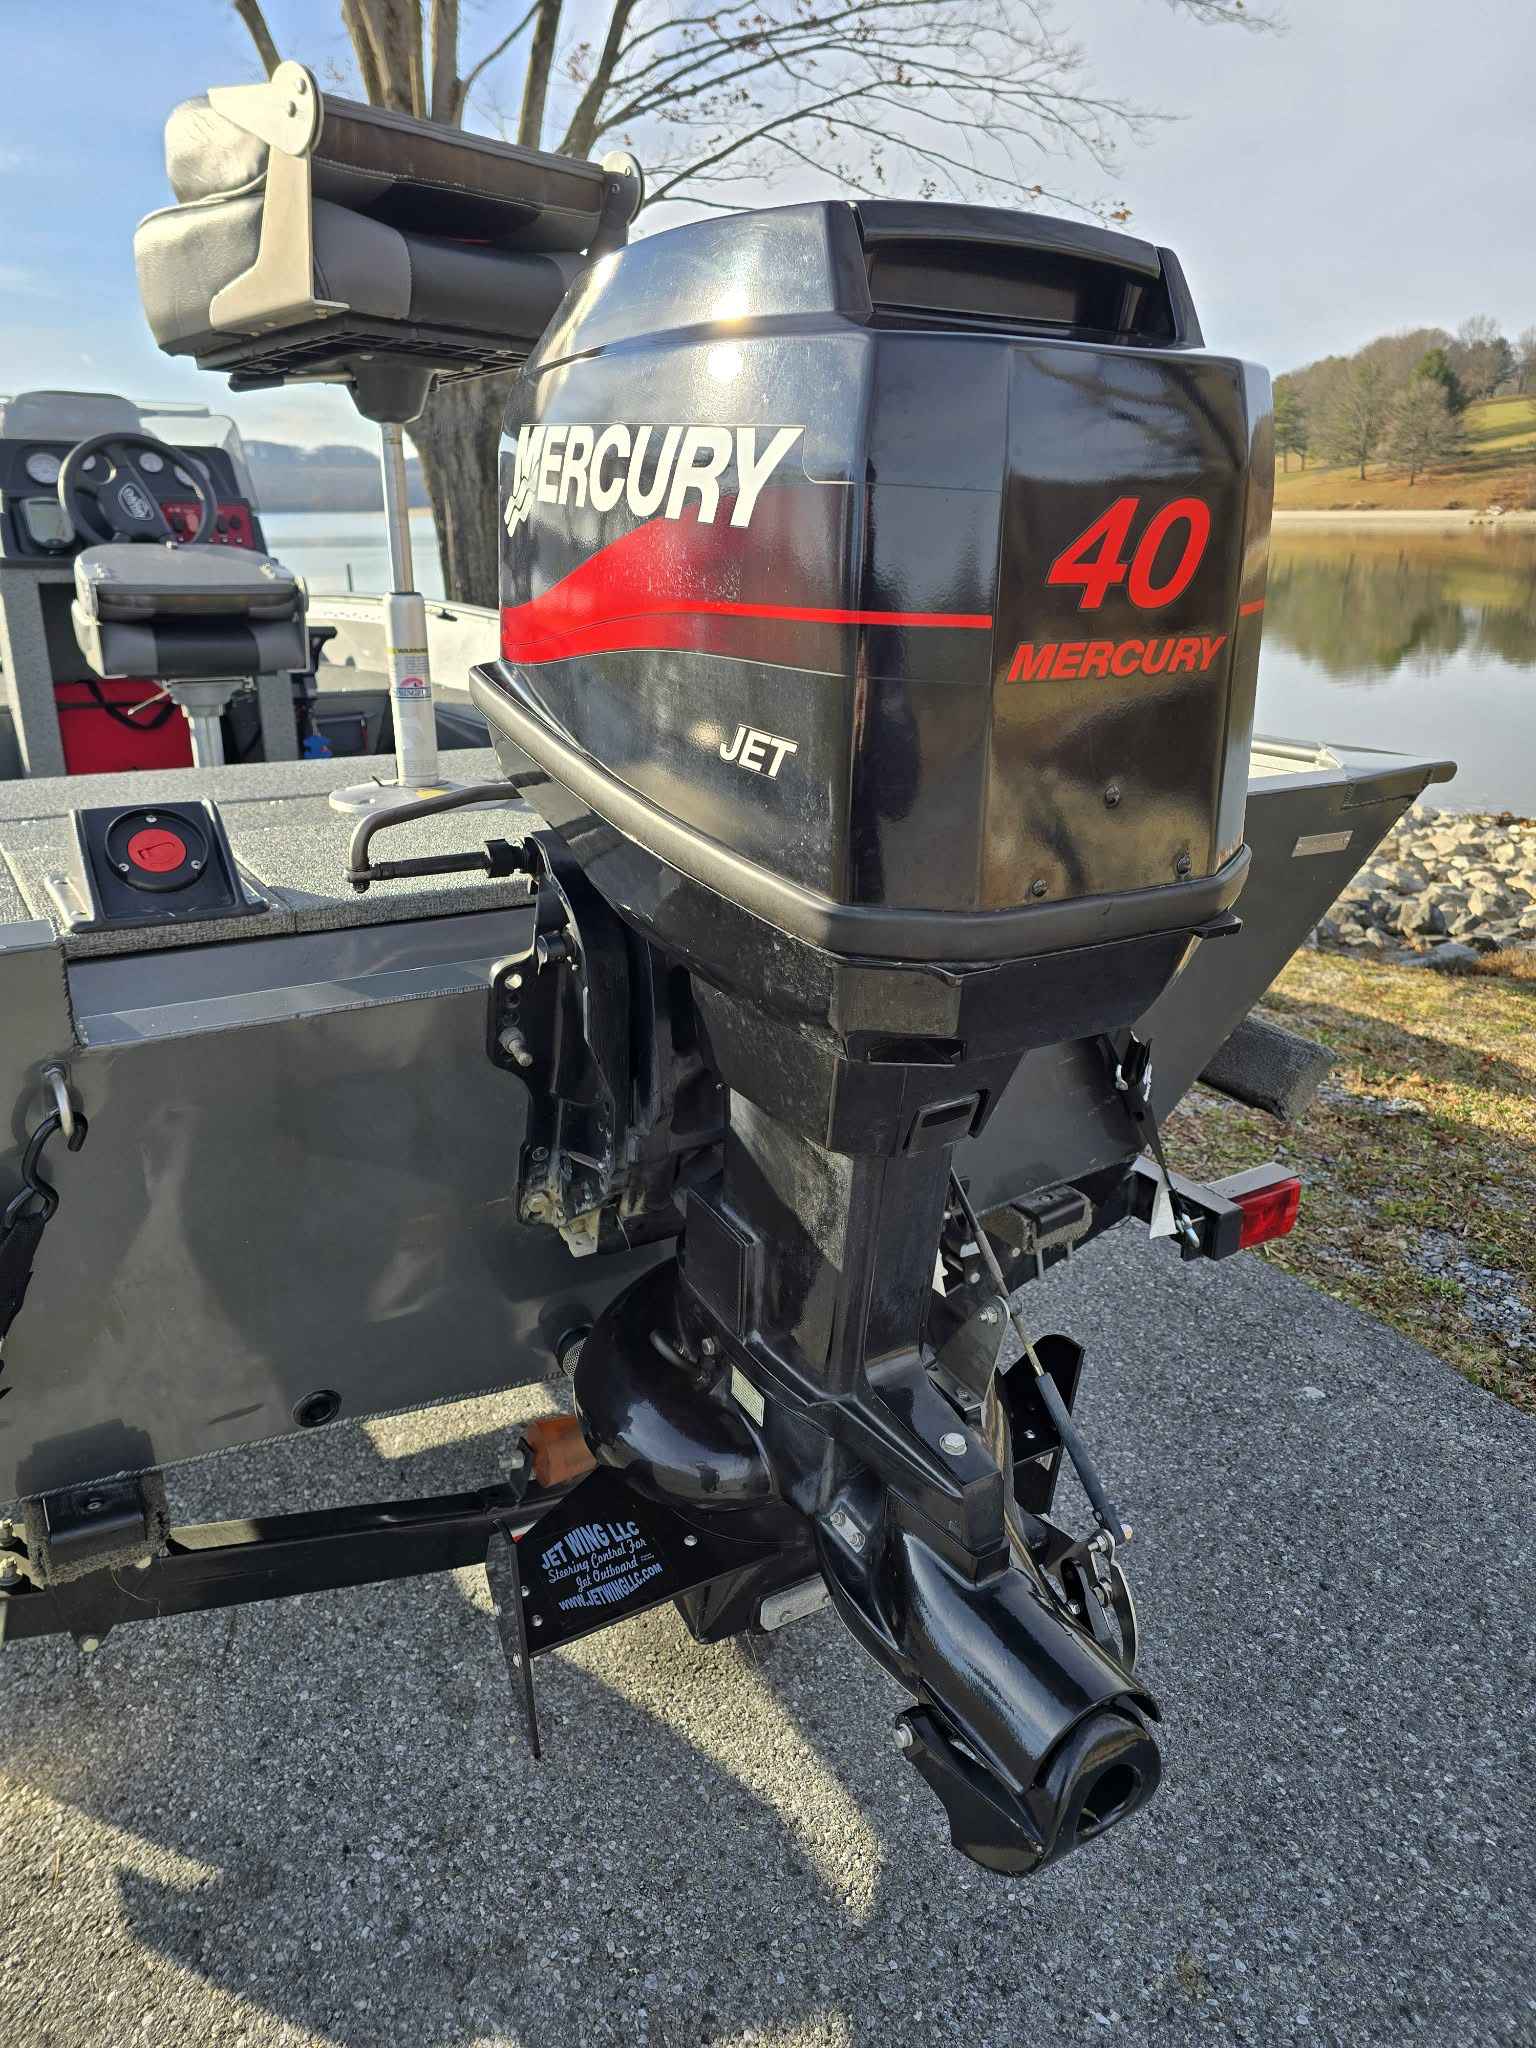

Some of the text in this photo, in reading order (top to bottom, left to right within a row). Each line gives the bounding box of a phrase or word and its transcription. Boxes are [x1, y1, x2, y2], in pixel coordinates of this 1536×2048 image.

[504, 424, 804, 537] MERCURY
[1046, 496, 1211, 610] 40
[1007, 636, 1228, 683] MERCURY
[719, 724, 799, 780] JET
[541, 1521, 640, 1570] JET WING LLC
[548, 1561, 590, 1584] Steering
[590, 1543, 627, 1569] Control
[627, 1537, 647, 1554] For
[575, 1575, 592, 1593] Jet
[592, 1555, 638, 1582] Outboard
